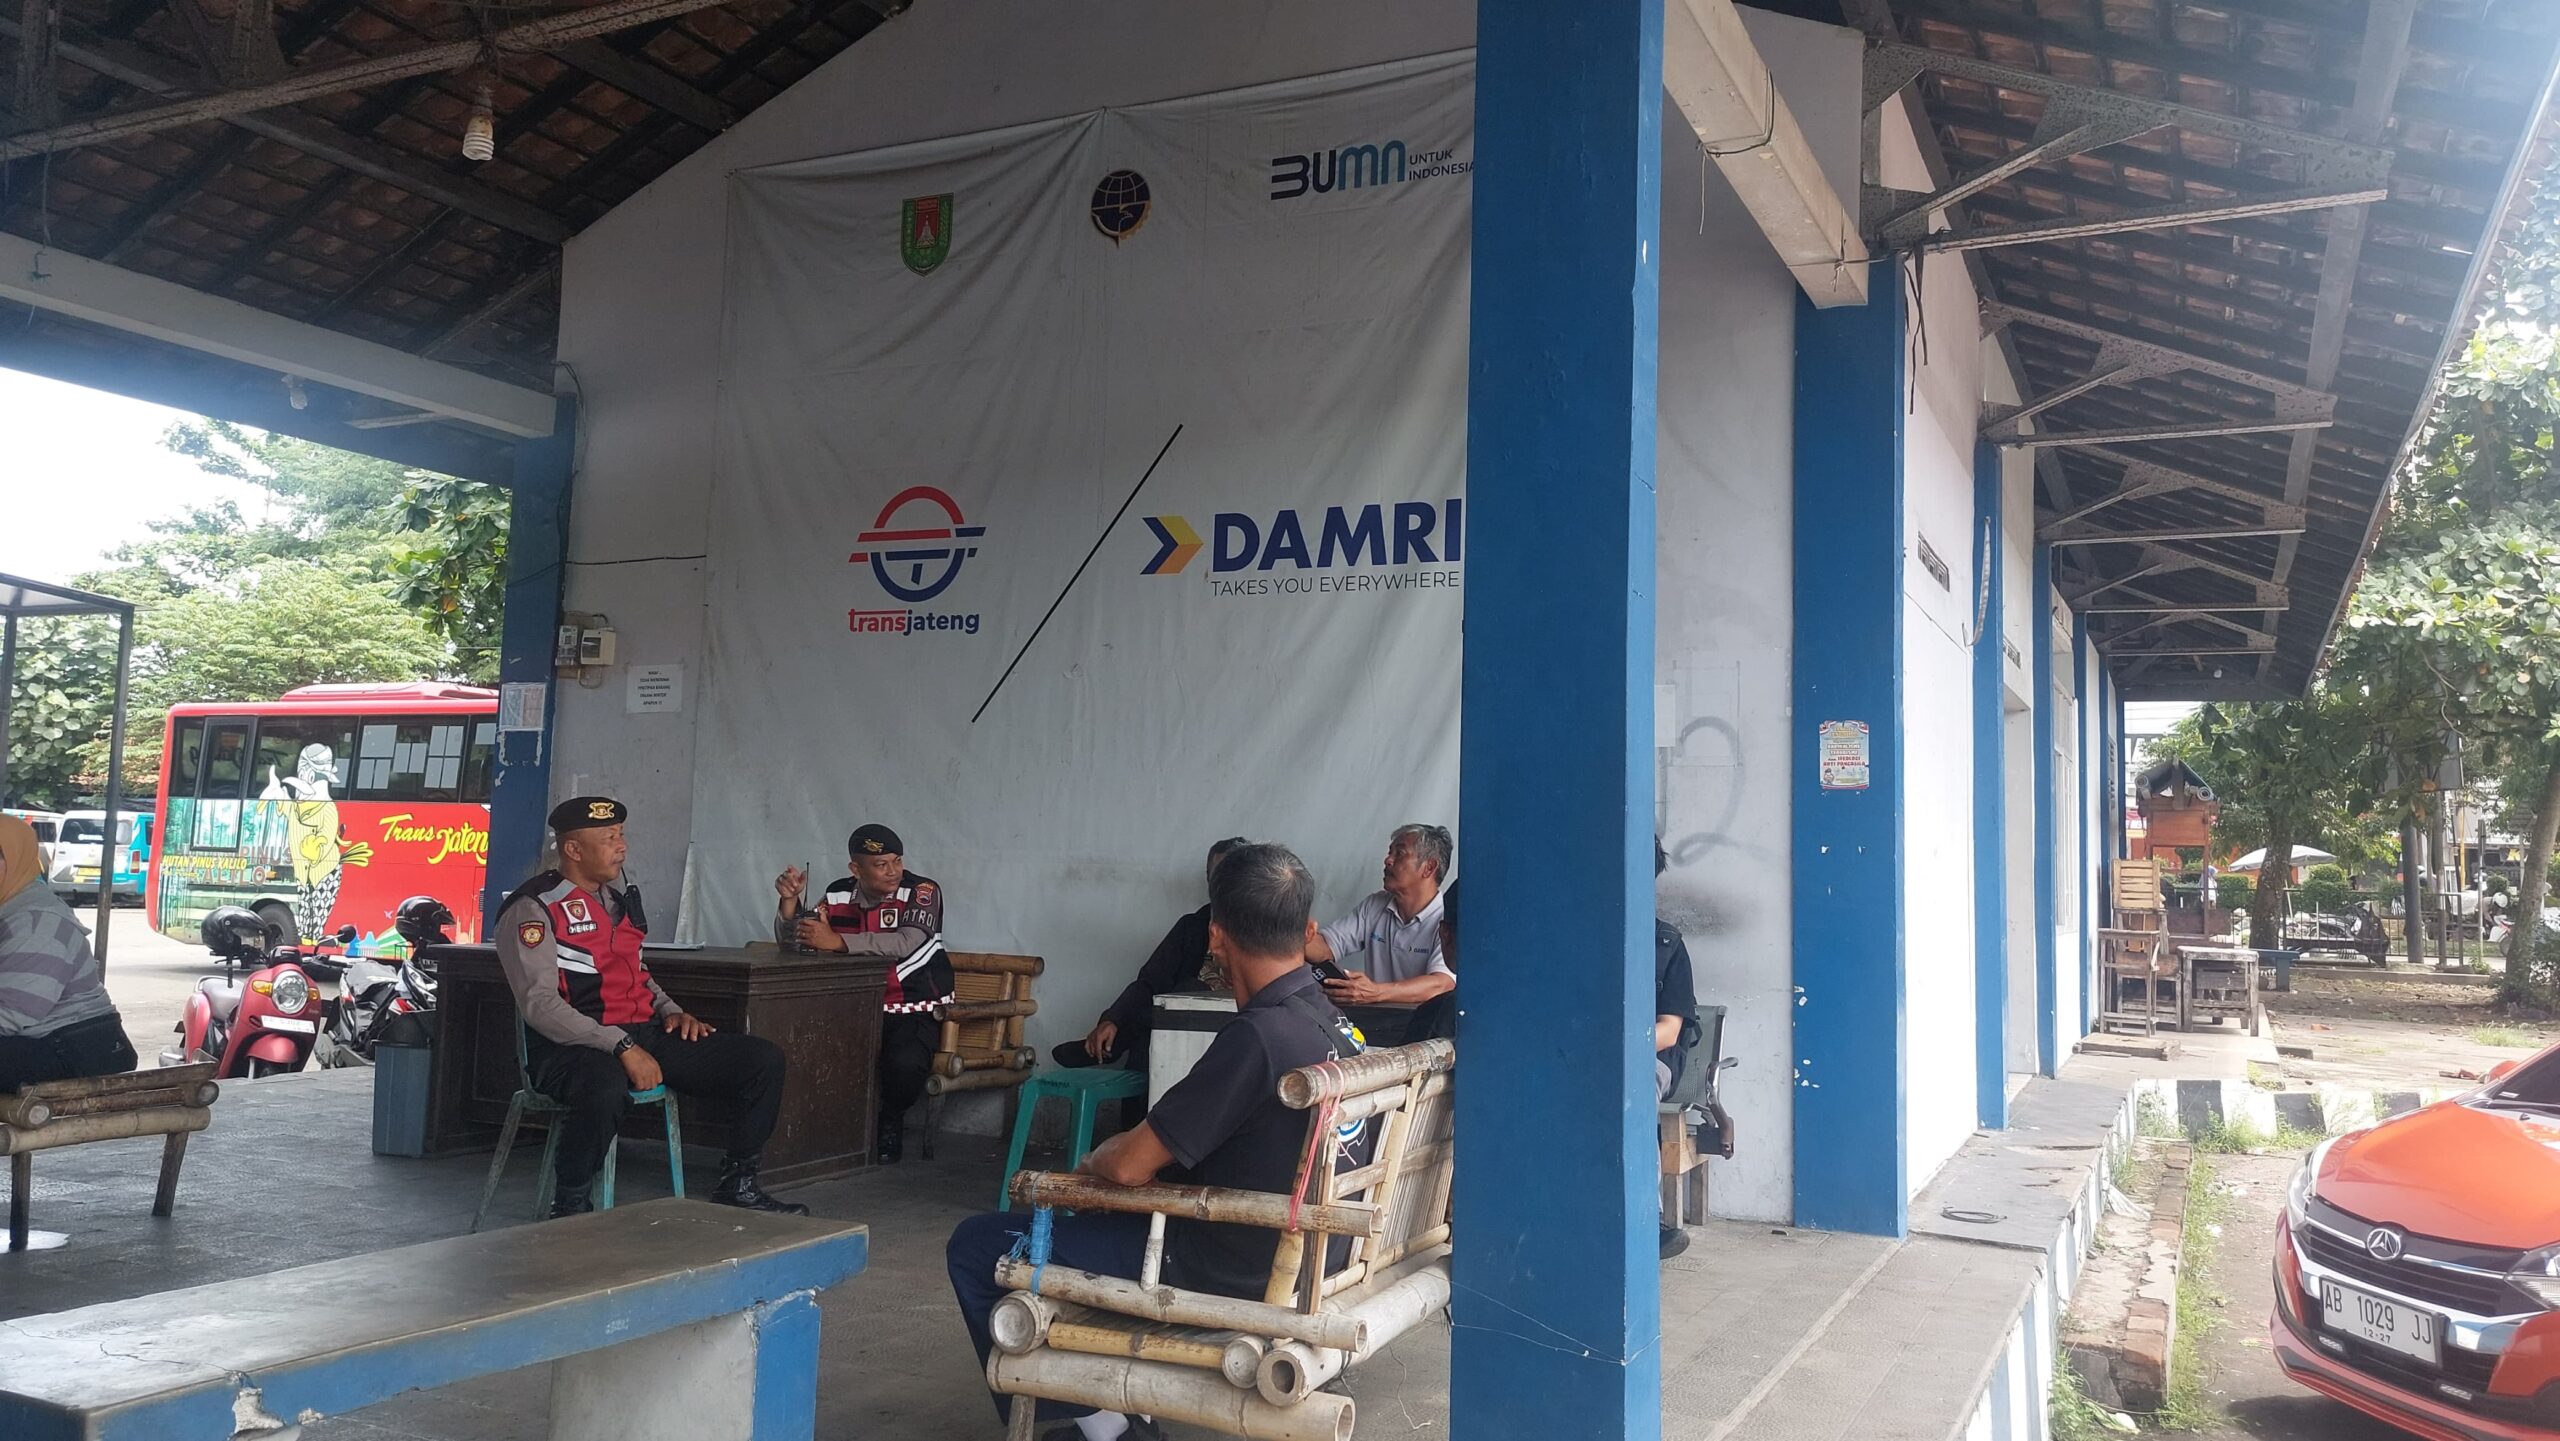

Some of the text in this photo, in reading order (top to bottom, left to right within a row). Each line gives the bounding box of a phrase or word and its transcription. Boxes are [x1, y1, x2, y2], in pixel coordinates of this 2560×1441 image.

[1271, 140, 1406, 200] BUMN
[1409, 149, 1453, 165] UNTUK
[1212, 498, 1462, 573] DAMRI
[1211, 571, 1460, 597] TAKES YOU EVERYWHERE
[848, 608, 980, 636] transjateng
[379, 813, 490, 865] Trans Jaten
[162, 855, 248, 871] HUTAN PINUS KALILO
[2325, 1284, 2431, 1344] AB 1029 JJ
